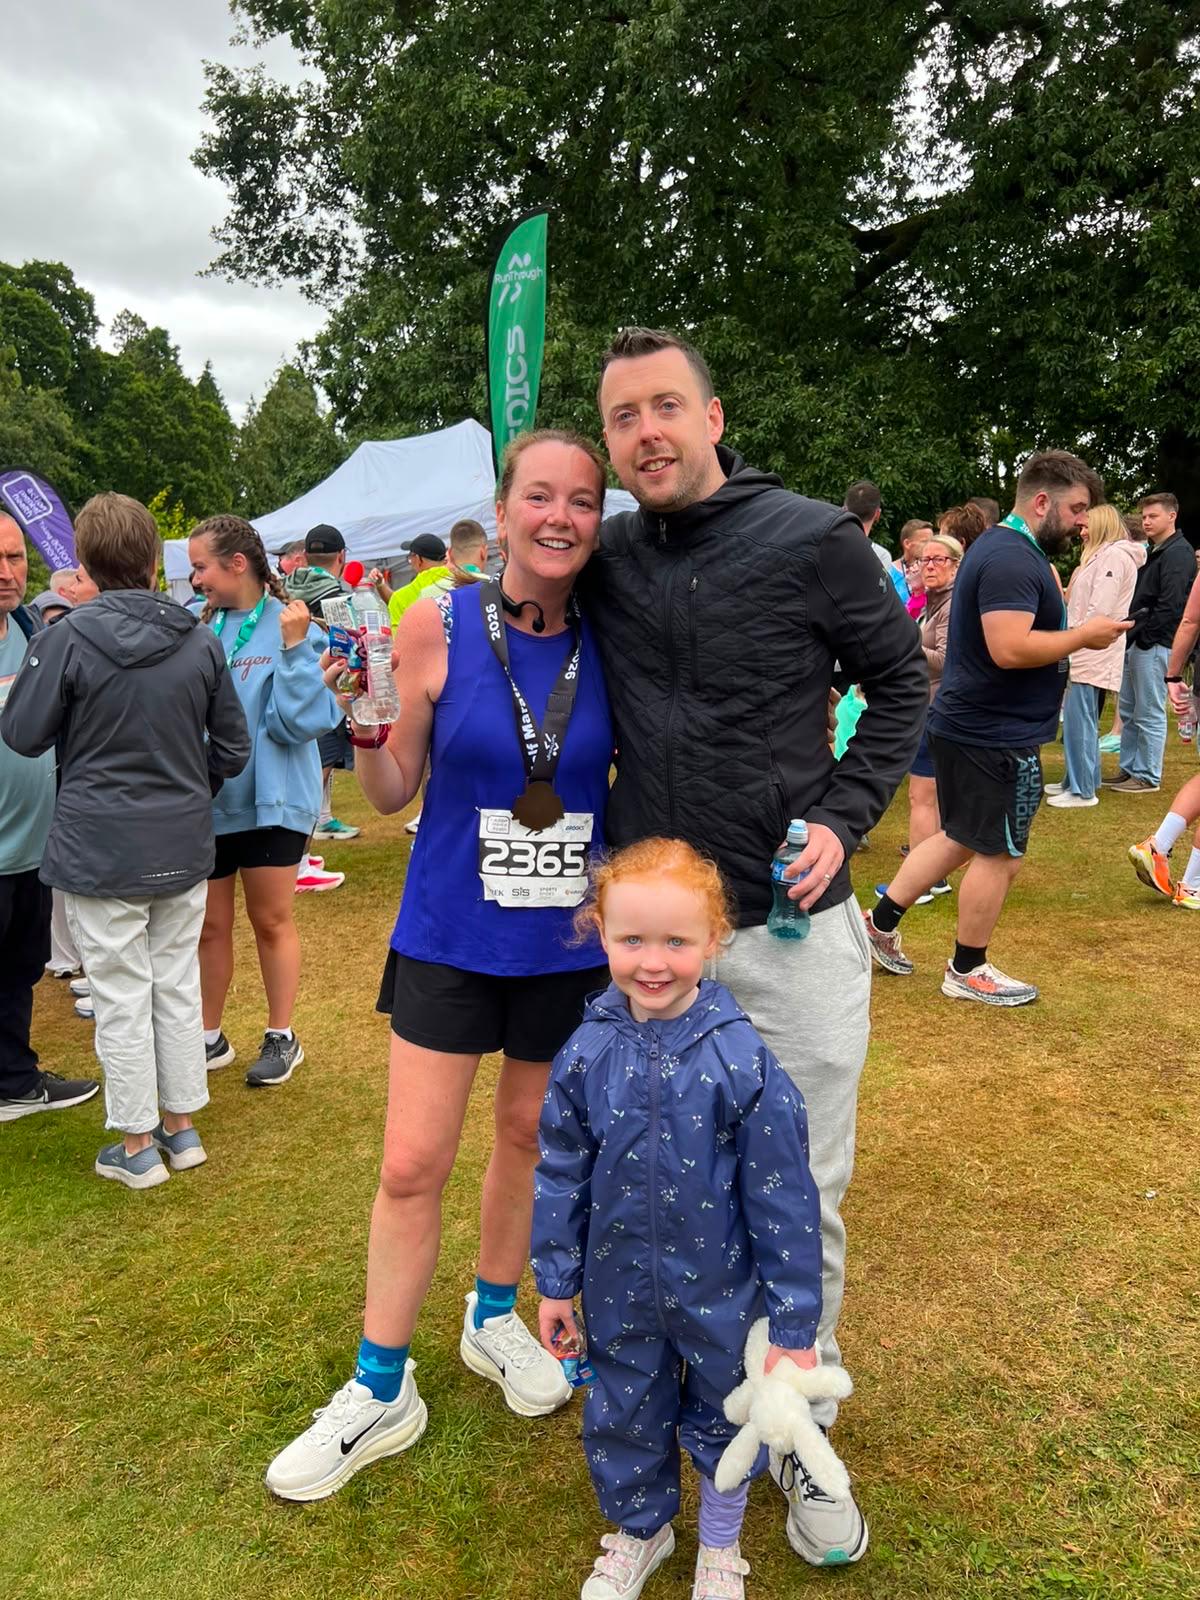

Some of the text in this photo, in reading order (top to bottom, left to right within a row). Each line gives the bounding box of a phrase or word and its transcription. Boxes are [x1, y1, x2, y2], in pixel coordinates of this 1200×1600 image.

[495, 266, 543, 284] RunThrough
[485, 603, 501, 641] 2026
[231, 655, 273, 681] agen
[564, 648, 580, 680] 026
[482, 840, 585, 876] 2365
